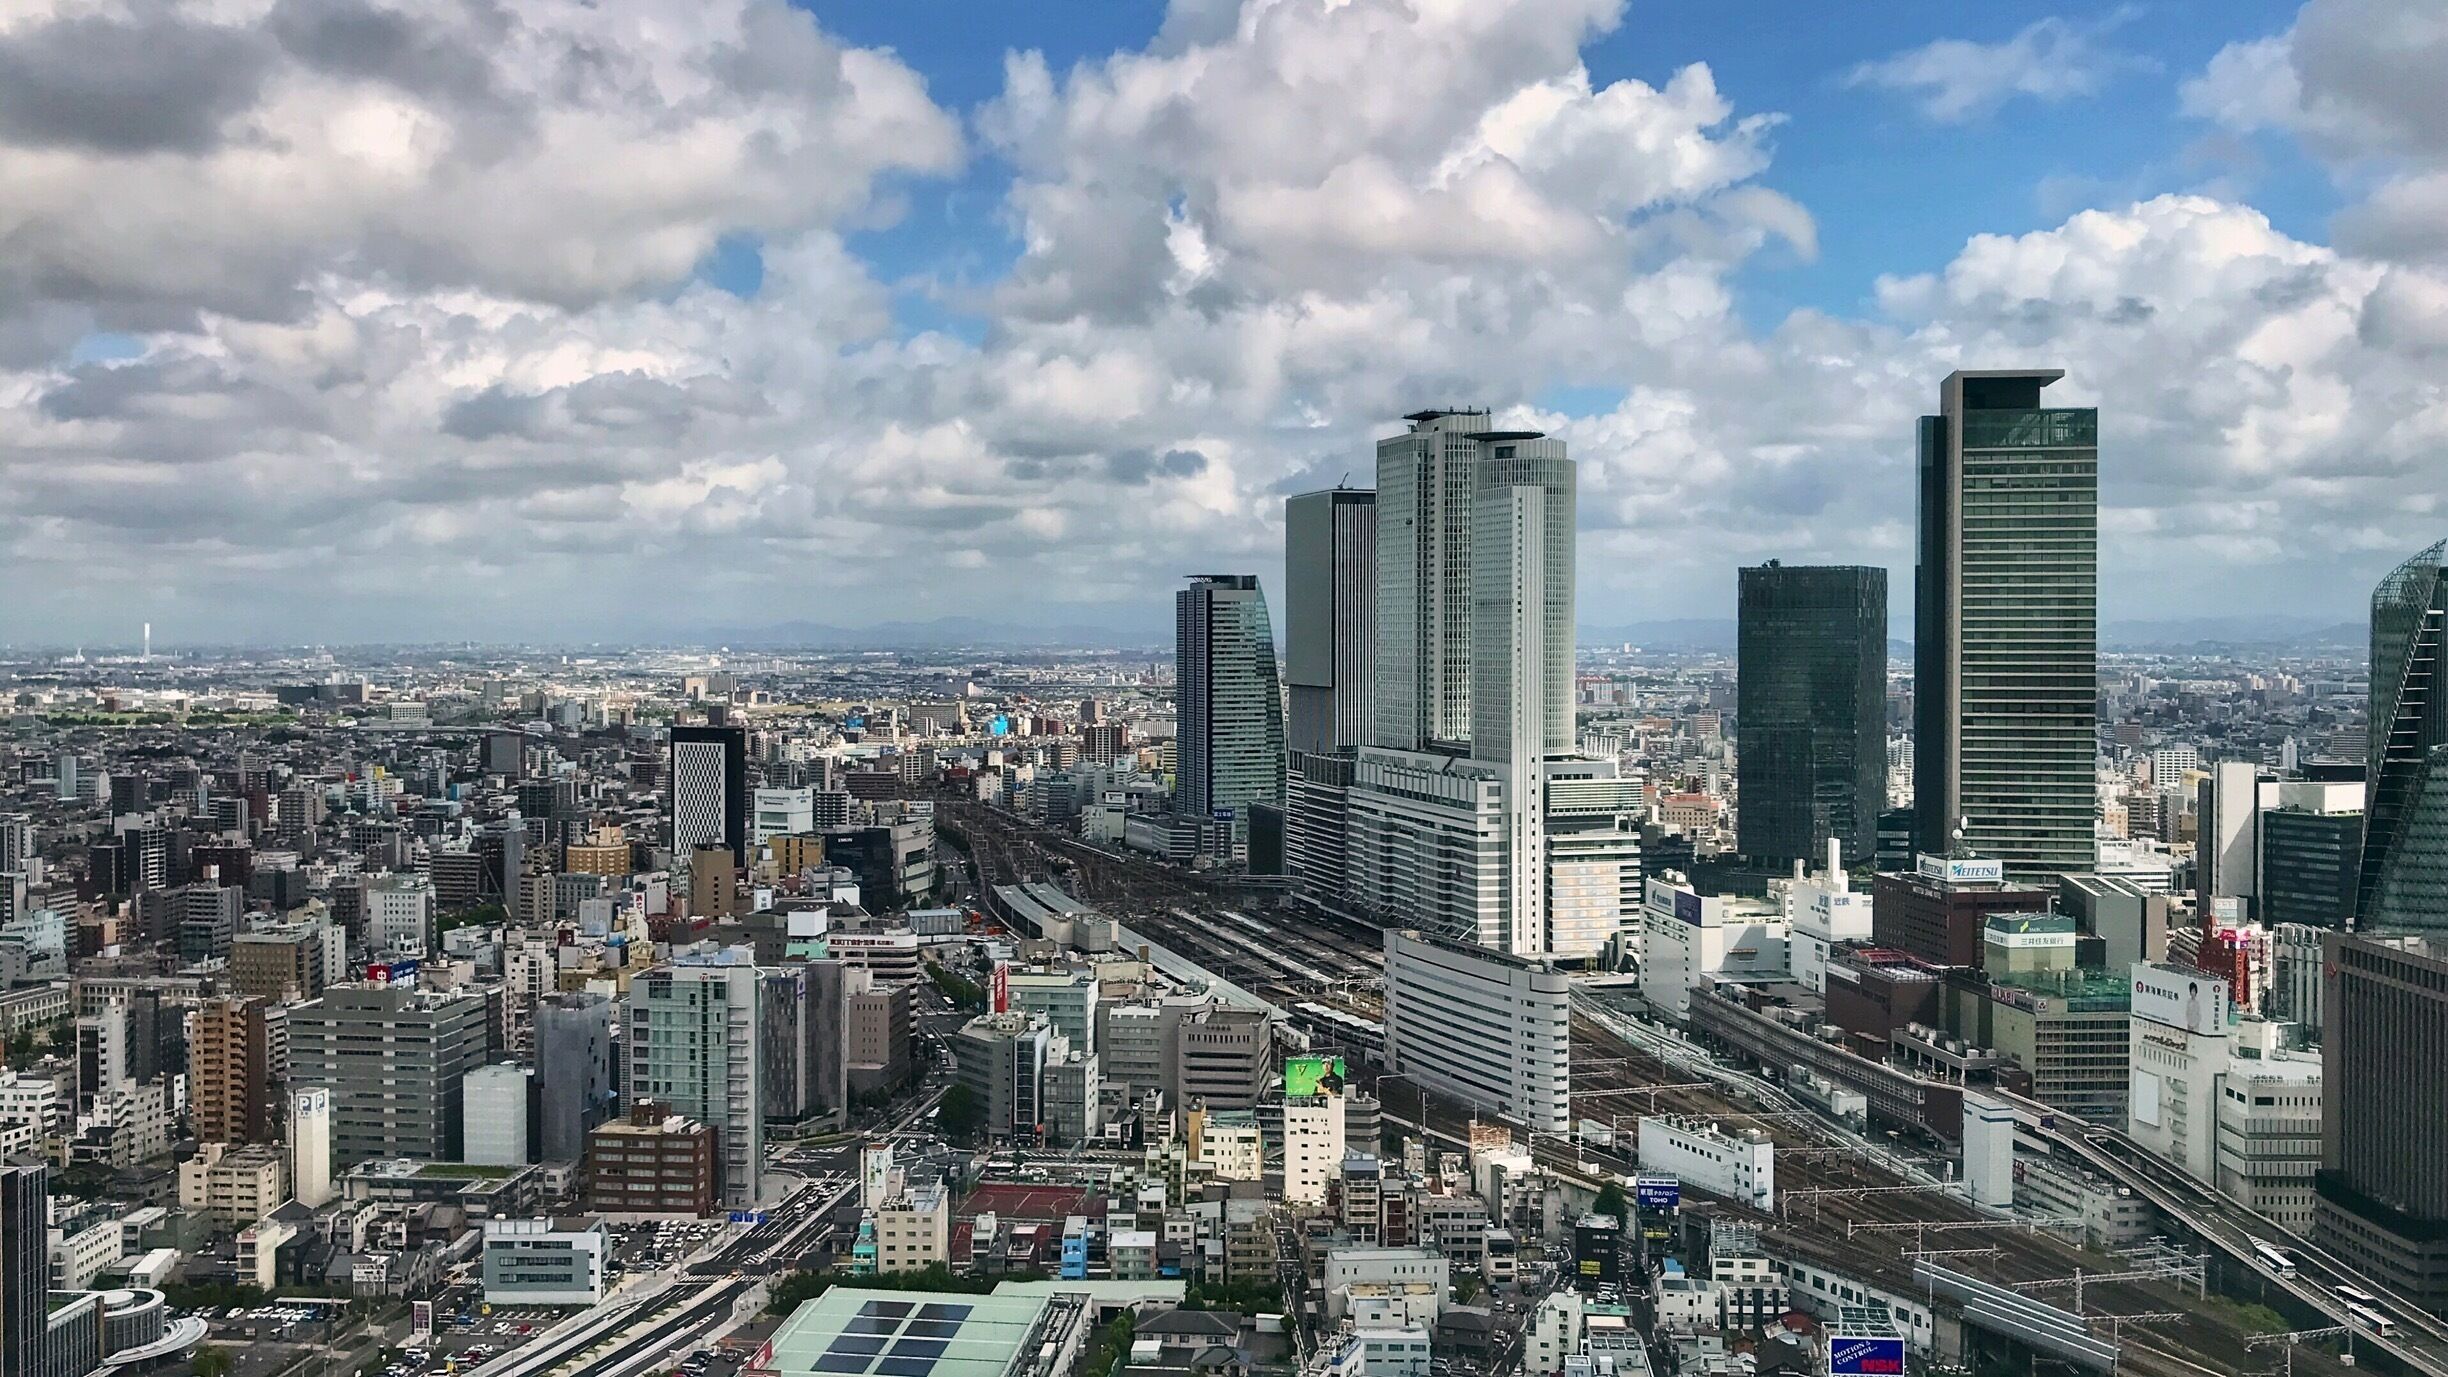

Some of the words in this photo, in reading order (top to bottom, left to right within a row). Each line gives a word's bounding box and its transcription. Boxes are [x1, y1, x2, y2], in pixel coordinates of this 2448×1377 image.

[1952, 862, 1998, 877] MEITETSU
[2021, 936, 2064, 946] 三井住友銀行
[299, 1097, 310, 1111] P
[1833, 1341, 1865, 1360] MOTION
[1836, 1346, 1874, 1365] CONTROL
[1861, 1359, 1901, 1373] NSK
